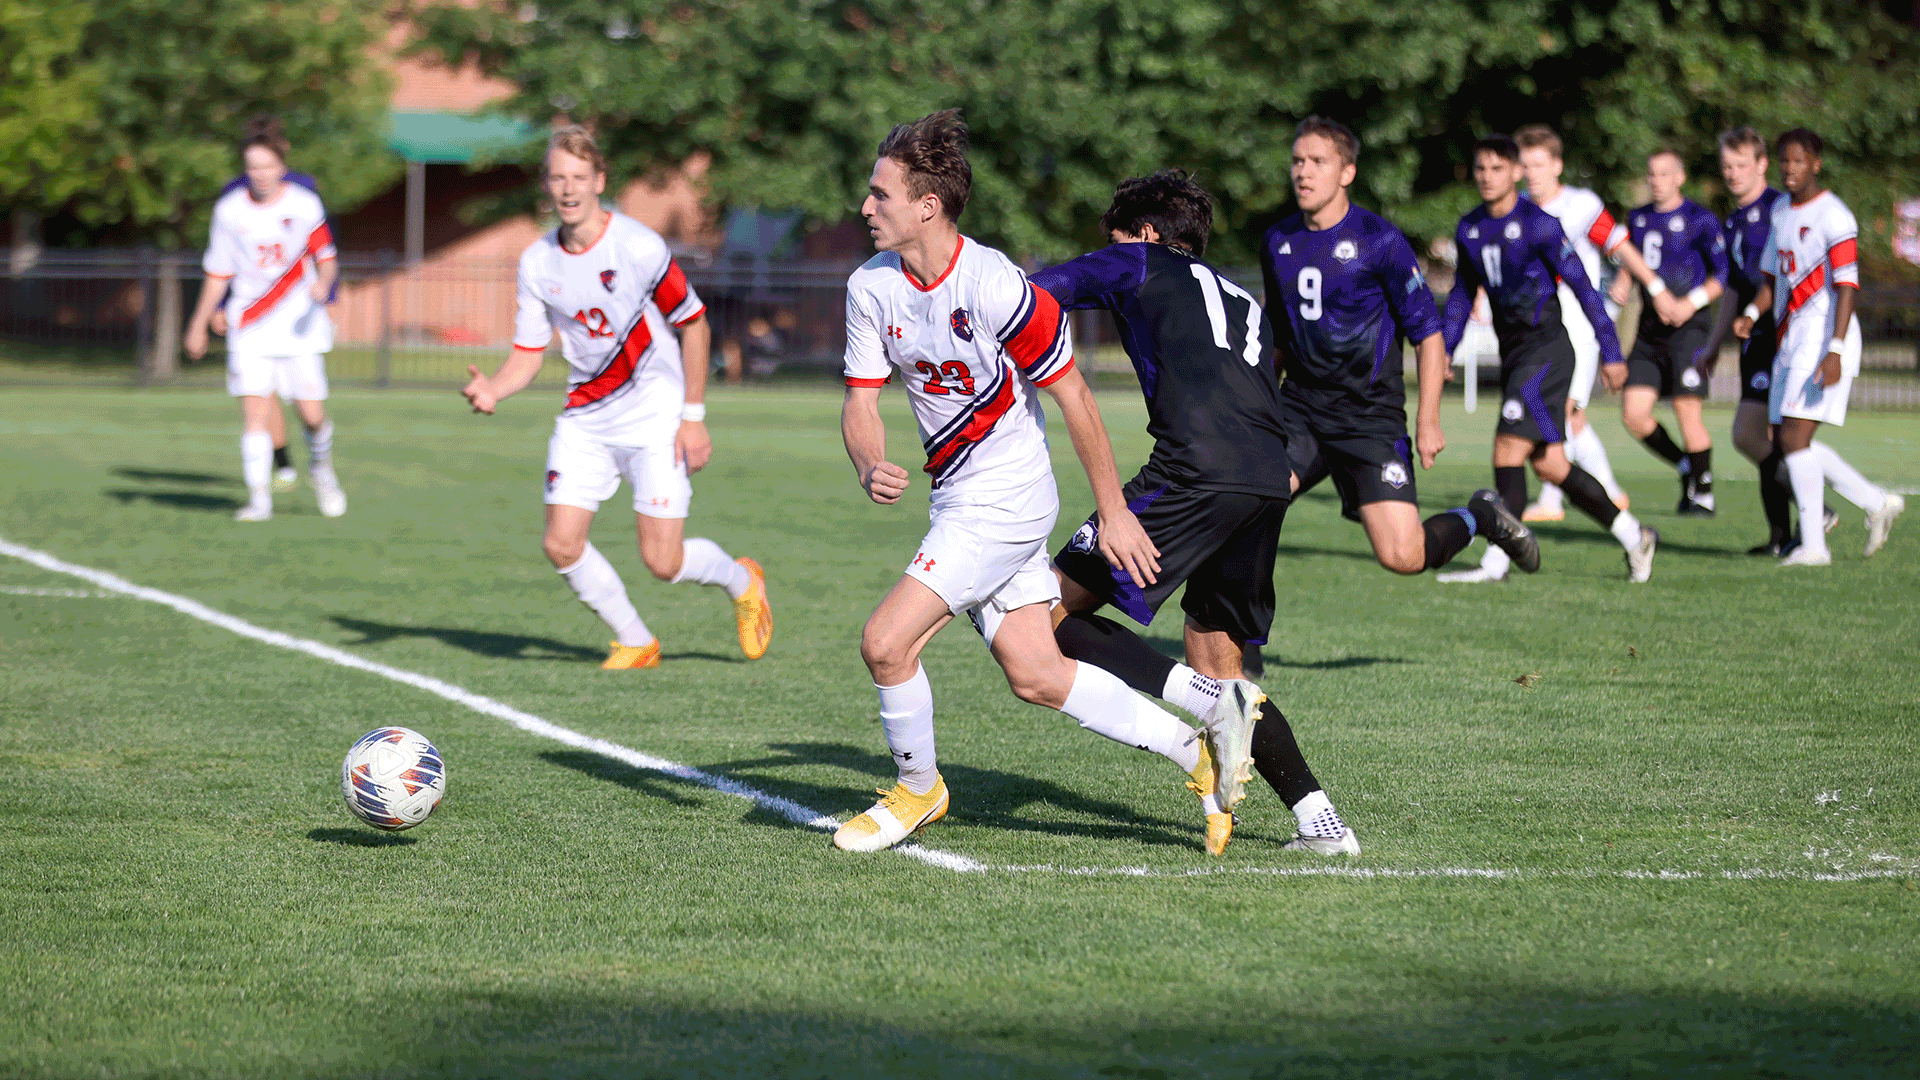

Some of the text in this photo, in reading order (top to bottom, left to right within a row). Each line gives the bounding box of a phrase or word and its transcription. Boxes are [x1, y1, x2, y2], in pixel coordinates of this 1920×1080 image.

[1643, 231, 1663, 270] 6
[1298, 266, 1323, 321] 9
[574, 307, 615, 338] 12
[1189, 263, 1262, 367] 17
[915, 360, 975, 396] 23
